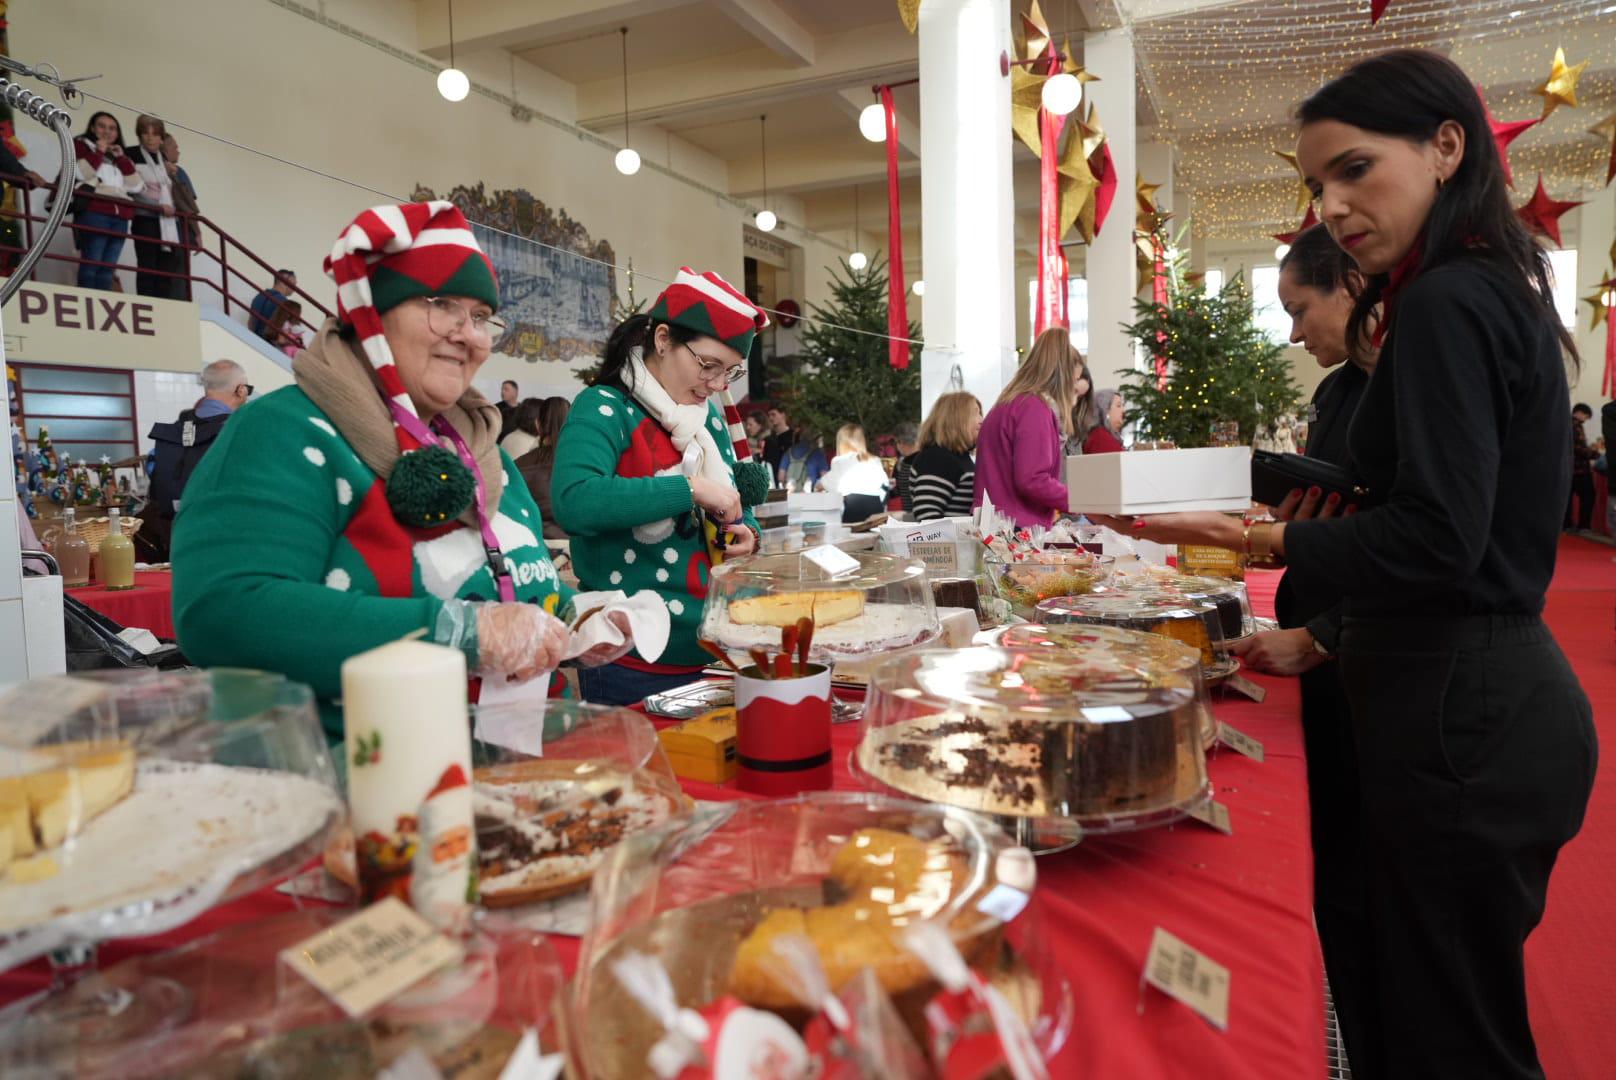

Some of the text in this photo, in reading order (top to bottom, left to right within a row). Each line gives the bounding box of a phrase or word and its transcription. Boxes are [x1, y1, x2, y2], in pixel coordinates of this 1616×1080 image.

[19, 289, 156, 336] PEIXE
[926, 531, 941, 541] WAY
[912, 546, 952, 555] ESTRELAS DE
